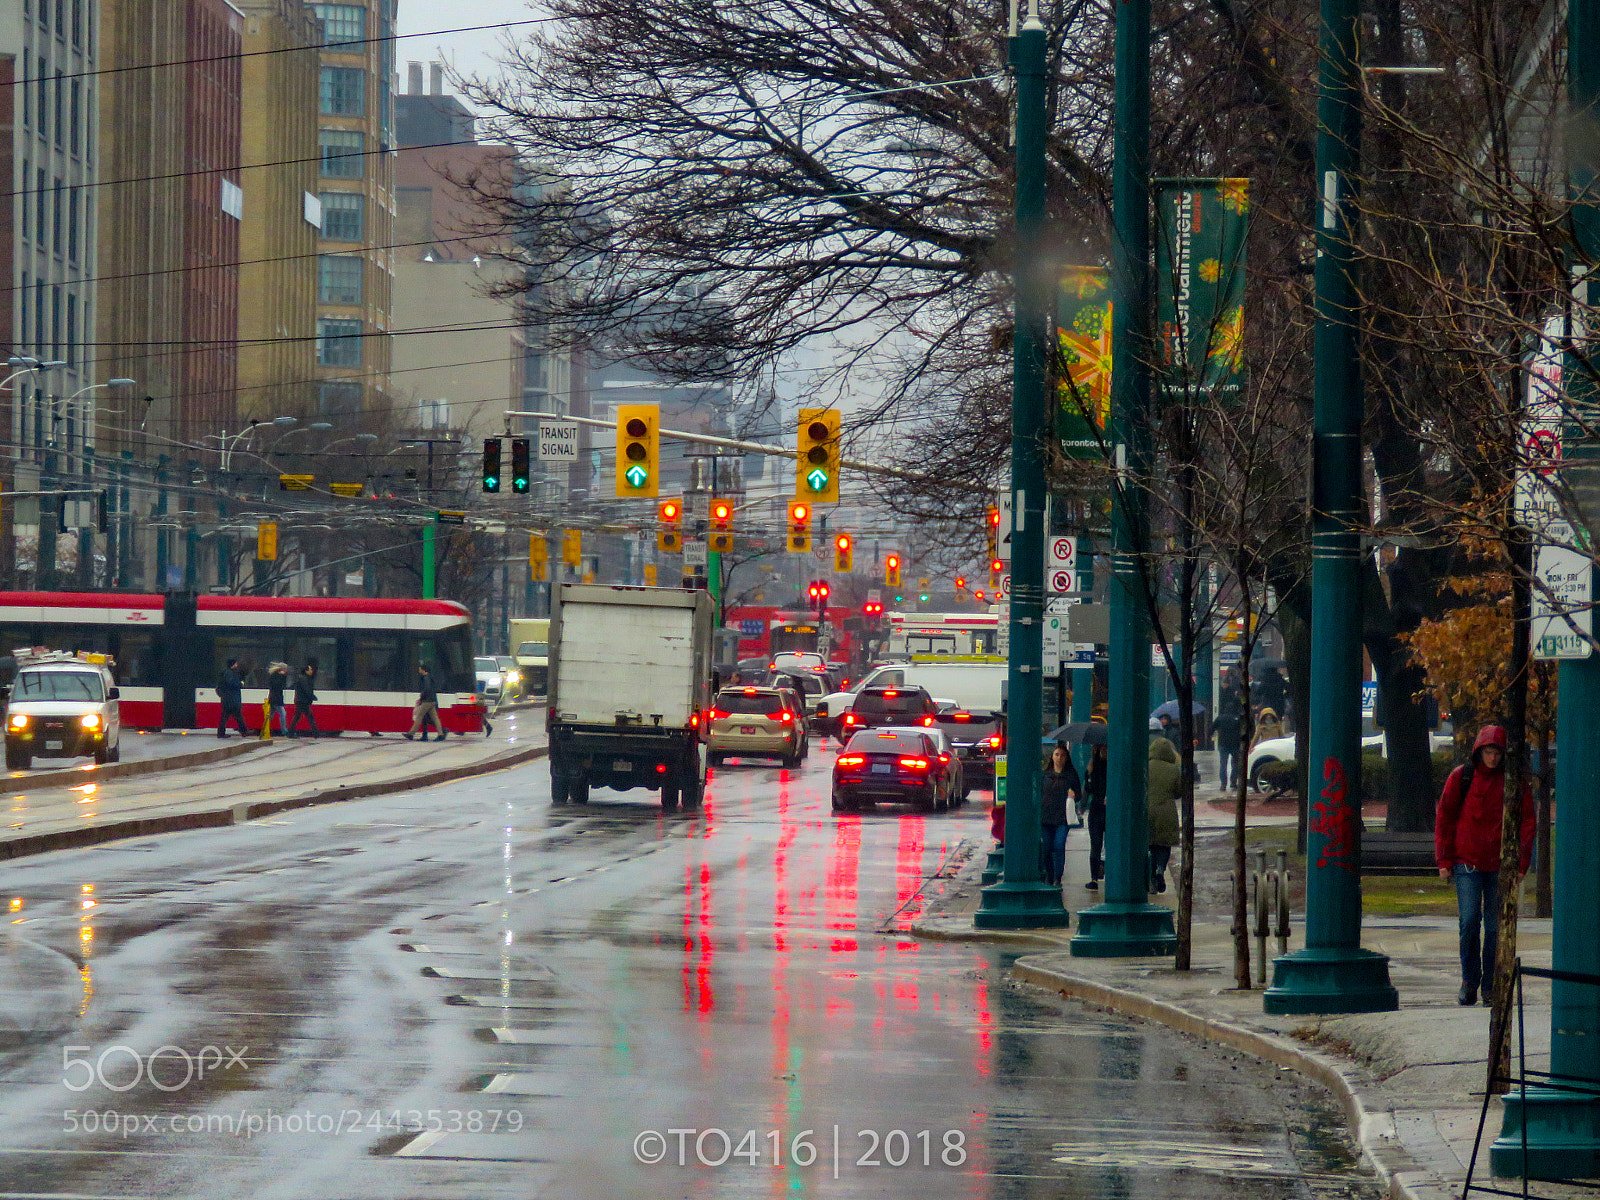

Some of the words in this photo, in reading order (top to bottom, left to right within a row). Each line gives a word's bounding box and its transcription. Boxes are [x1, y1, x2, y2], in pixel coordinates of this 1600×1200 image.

[1172, 191, 1192, 366] entertainment
[540, 427, 577, 439] TRANSIT
[542, 444, 574, 456] SIGNAL
[1547, 574, 1562, 582] MON
[1567, 573, 1578, 581] FRI
[1577, 583, 1586, 592] PM
[1556, 635, 1582, 649] 3115
